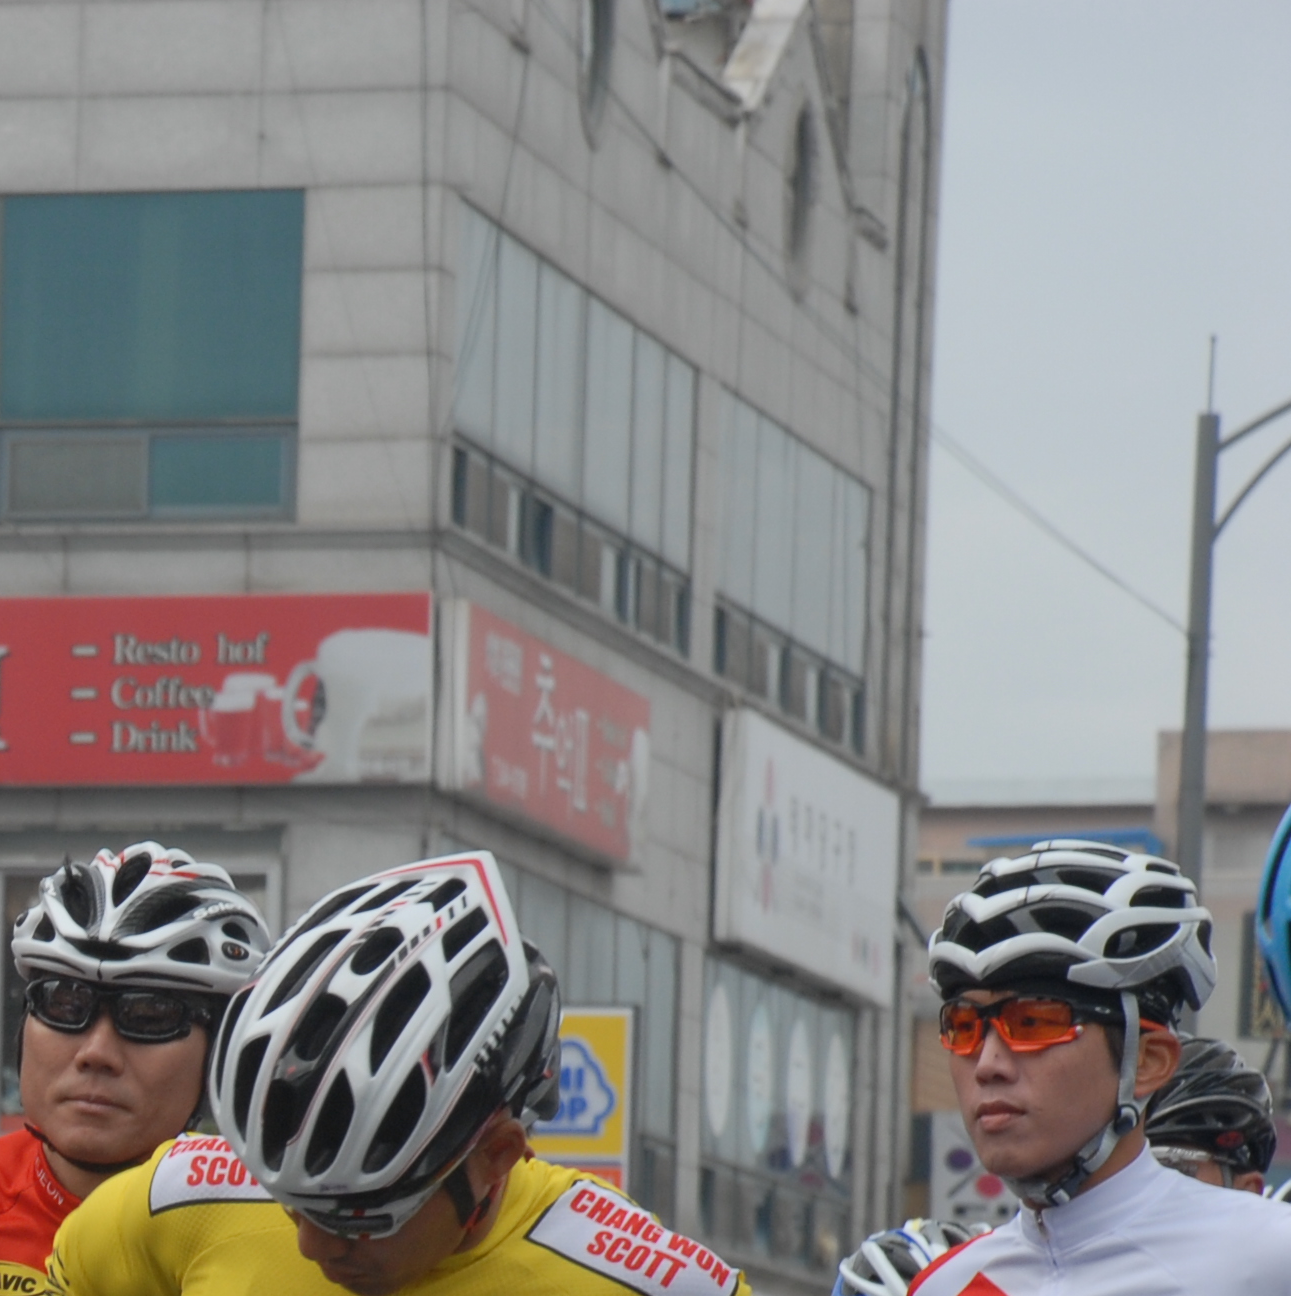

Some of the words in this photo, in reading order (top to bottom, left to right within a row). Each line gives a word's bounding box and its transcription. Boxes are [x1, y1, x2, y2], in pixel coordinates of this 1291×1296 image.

[112, 634, 201, 665] Resto
[110, 677, 216, 710] Coffee
[110, 720, 199, 753] Drink
[569, 1188, 665, 1241] CHANG
[668, 1227, 732, 1288] WON
[587, 1230, 687, 1288] SCOTT
